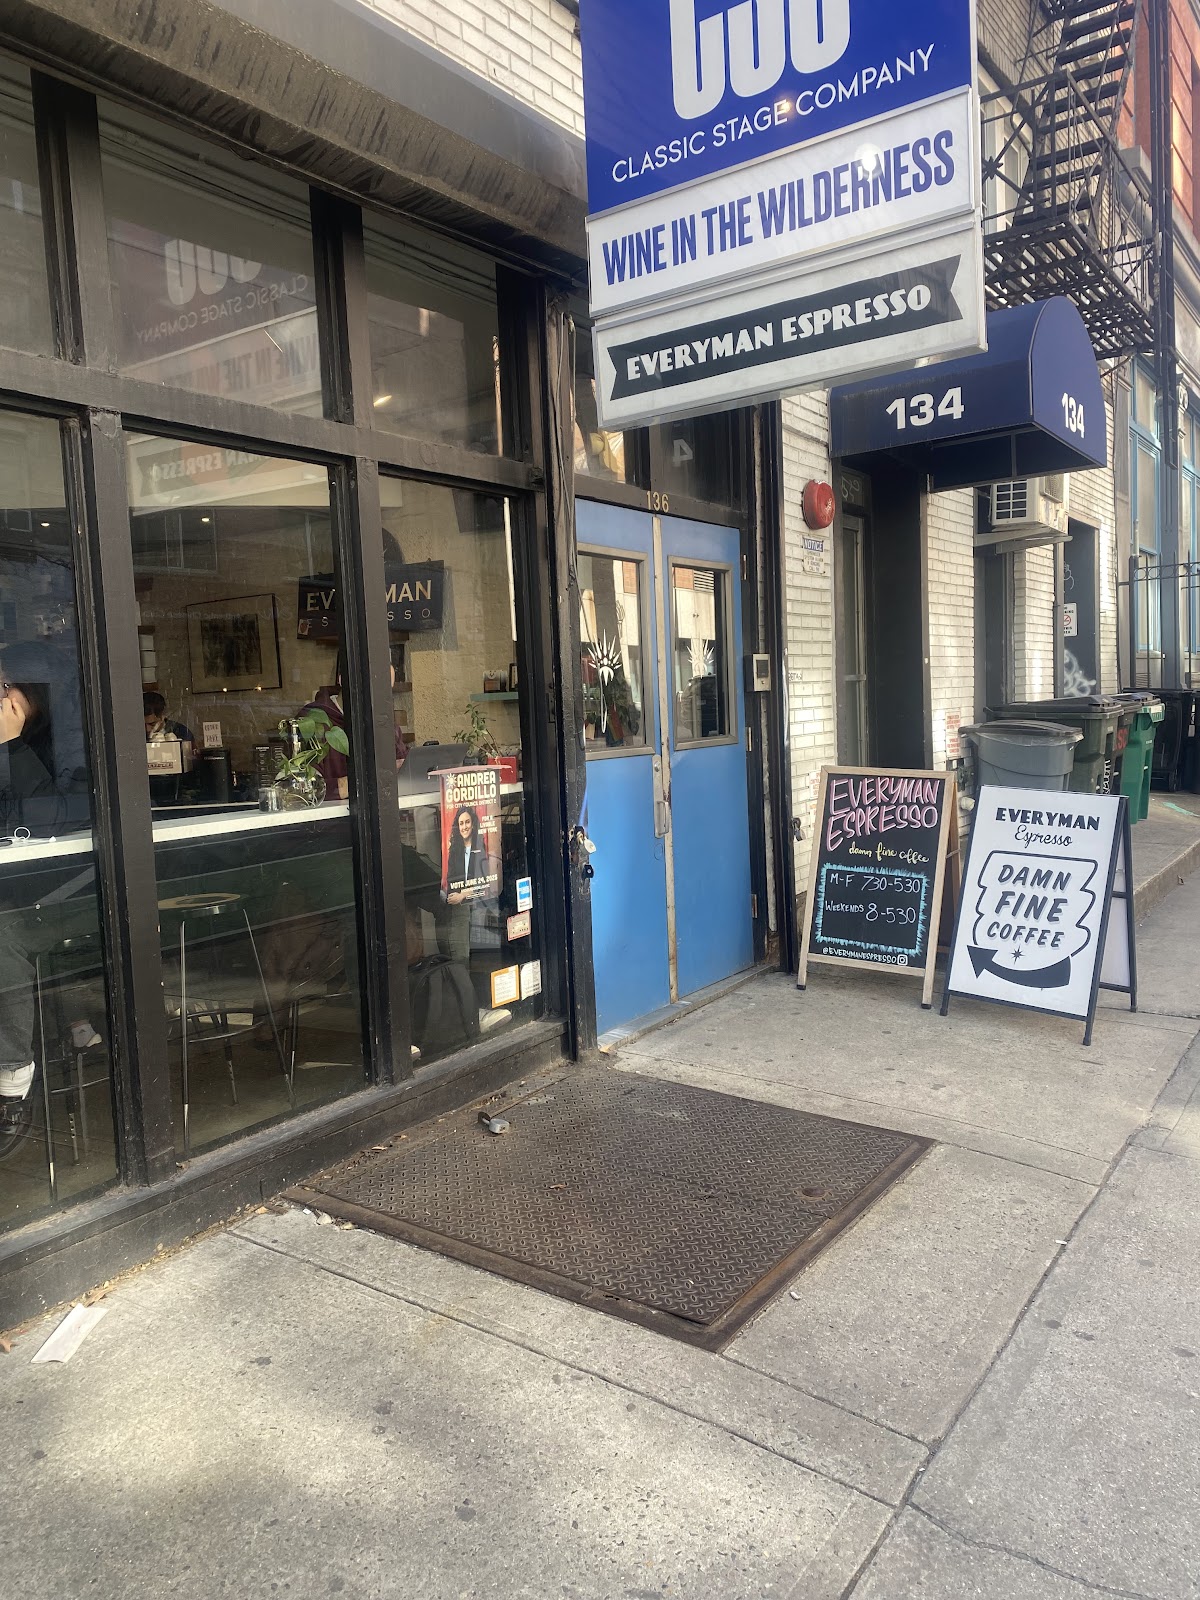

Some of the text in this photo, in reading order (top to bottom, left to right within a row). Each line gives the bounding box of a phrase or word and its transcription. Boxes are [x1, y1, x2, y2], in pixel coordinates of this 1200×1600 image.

[612, 131, 706, 183] CLASSIC
[712, 99, 789, 147] STAGE
[795, 43, 935, 116] COMPANY
[601, 129, 955, 286] WINE IN THE WILDERNESS
[626, 284, 932, 381] EVERYMAN ESPRESSO
[885, 387, 965, 430] 134
[1061, 392, 1085, 439] 134
[646, 490, 669, 513] 136
[457, 771, 496, 787] ANDREA
[446, 784, 497, 803] GORDILLO
[830, 777, 940, 816] EVERYMAN
[827, 805, 938, 852] ESPRESSO
[995, 807, 1100, 831] EVERYMAN
[1014, 824, 1073, 848] Espresso
[849, 841, 872, 858] damn
[875, 842, 897, 863] fine
[450, 881, 464, 890] VOTE
[465, 878, 477, 887] JUNE
[830, 873, 921, 893] M-F 730-530
[998, 864, 1072, 891] DAMN
[865, 902, 917, 925] 8-530
[994, 890, 1068, 922] FINE
[987, 921, 1065, 948] COFFEE
[822, 947, 897, 964] @EVERYMANESPRESSO
